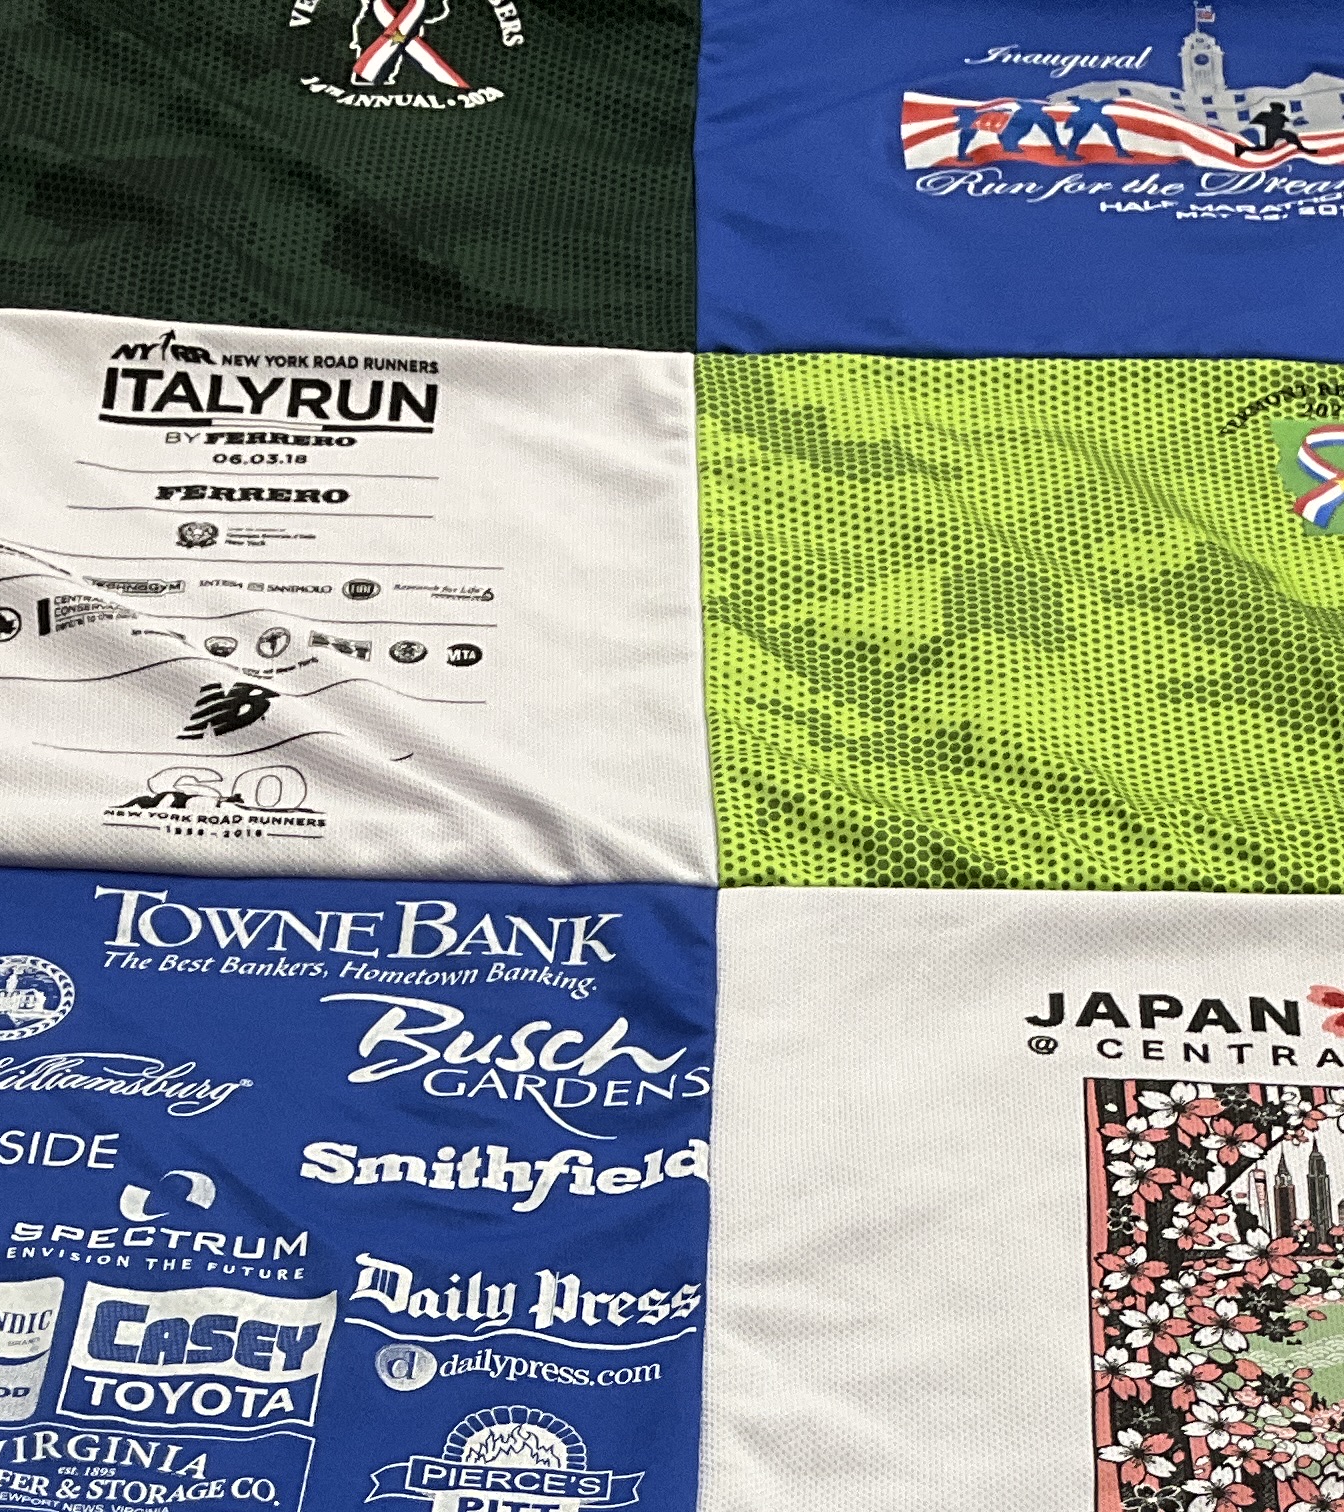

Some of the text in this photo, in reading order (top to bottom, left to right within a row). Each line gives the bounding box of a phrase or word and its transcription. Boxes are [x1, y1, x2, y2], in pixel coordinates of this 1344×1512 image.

[964, 44, 1153, 78] Inaugural
[914, 168, 1041, 197] Run
[1027, 172, 1116, 203] for
[1120, 172, 1185, 196] the
[222, 354, 260, 367] NEW
[265, 356, 309, 369] YORK
[313, 358, 358, 370] ROAD
[364, 359, 439, 374] RUNNERS
[101, 367, 438, 423] ITALYRUN
[165, 432, 357, 447] BY FERRERO
[212, 453, 307, 465] 06.03.18
[155, 485, 352, 504] FERRERO
[149, 811, 326, 827] YORK ROAD RUNNERS
[94, 886, 624, 966] TOWNE BANK
[103, 950, 599, 998] The Best Bankers, Hometown Banking.
[1026, 992, 1301, 1037] JAPAN
[320, 993, 688, 1083] Busch
[1027, 1035, 1058, 1055] @
[422, 1066, 712, 1139] GARDENS
[299, 1139, 712, 1213] Smithfield
[10, 1222, 309, 1261] SPECTRUM
[6, 1247, 306, 1281] ENVISION THE FUTURE
[349, 1252, 702, 1332] Daily Press
[87, 1299, 322, 1372] CASEY
[440, 1351, 661, 1388] dailypress.com
[83, 1375, 295, 1419] TOYOTA
[83, 1466, 116, 1477] 1895
[421, 1465, 601, 1496] PIERCE'S
[58, 1481, 81, 1499] &
[86, 1478, 226, 1504] STORAGE
[230, 1478, 281, 1507] CO.
